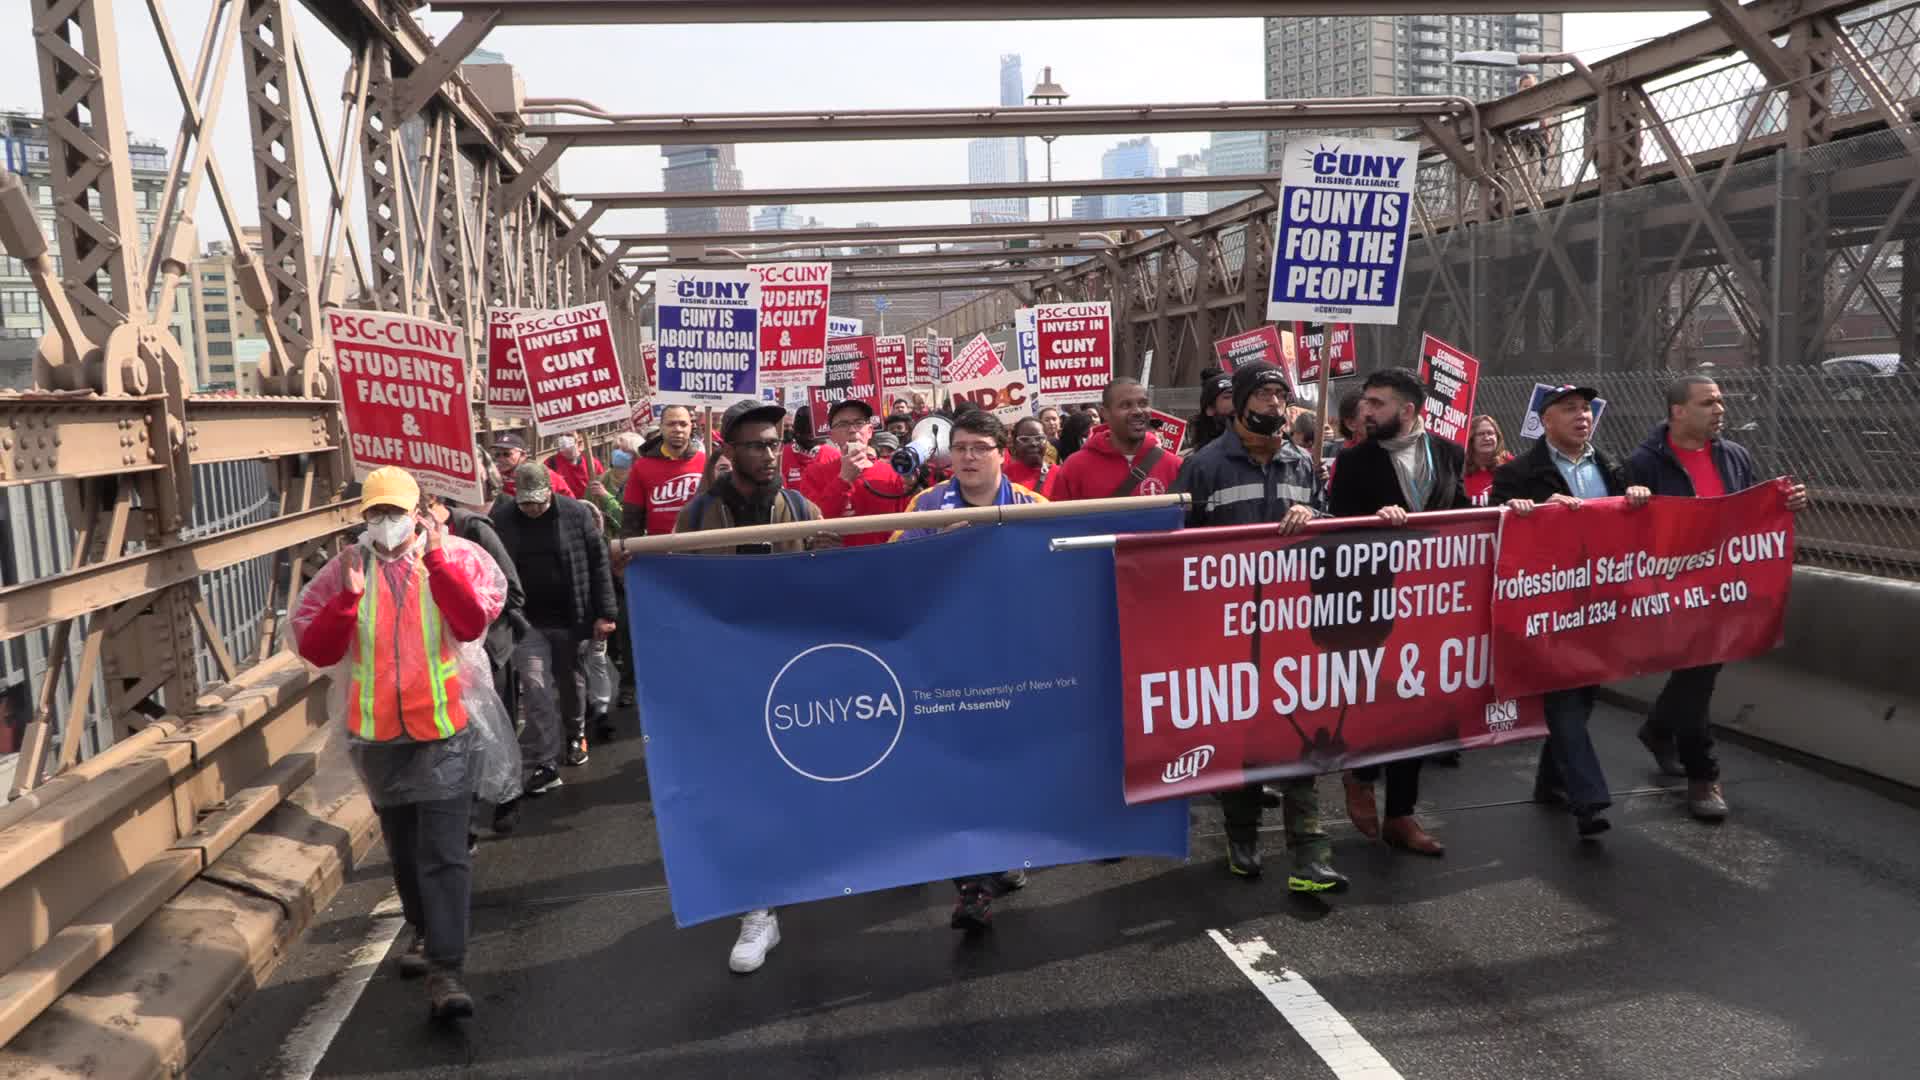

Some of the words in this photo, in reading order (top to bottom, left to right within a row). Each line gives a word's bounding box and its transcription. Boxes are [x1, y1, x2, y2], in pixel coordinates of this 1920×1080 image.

[1313, 152, 1405, 178] CUNY
[1314, 176, 1352, 186] RISING
[1354, 178, 1400, 188] ALLIANCE
[1290, 189, 1368, 225] CUNY
[1370, 193, 1400, 227] IS
[1285, 227, 1341, 263] FOR
[1348, 231, 1397, 264] THE
[750, 266, 828, 282] SC-CUNY
[1286, 266, 1386, 301] PEOPLE
[677, 281, 750, 299] CUNY
[516, 307, 601, 334] PSC-CUNY
[680, 308, 717, 328] CUNY
[719, 309, 734, 328] IS
[1037, 305, 1107, 319] PSC-CUNY
[330, 314, 457, 353] PSC-CUNY
[525, 329, 579, 351] INVEST
[583, 324, 603, 340] IN
[829, 322, 857, 333] UNY
[1042, 320, 1086, 333] INVEST
[1089, 319, 1104, 331] IN
[660, 328, 704, 350] ABOUT
[706, 330, 756, 351] RACIAL
[779, 329, 793, 347] &
[827, 342, 858, 355] CONOMIC
[1051, 337, 1097, 354] CUNY
[1300, 333, 1324, 349] FUND
[1330, 330, 1350, 345] UNY
[542, 347, 596, 373] CUNY
[665, 352, 676, 369] &
[678, 350, 749, 371] ECONOMIC
[781, 348, 823, 366] UNITED
[827, 350, 865, 362] PORTUNITY.
[1044, 357, 1087, 370] INVEST
[1090, 356, 1104, 367] IN
[1309, 348, 1319, 361] &
[339, 349, 463, 395] STUDENTS,
[537, 372, 589, 394] INVEST
[592, 368, 611, 383] IN
[680, 371, 734, 391] JUSTICE
[885, 376, 907, 385] YORK
[1040, 376, 1070, 390] NEW
[1072, 372, 1109, 387] YORK
[356, 379, 452, 416] FACULTY
[490, 389, 526, 402] NEW
[536, 397, 573, 418] NEW
[576, 386, 623, 409] YORK
[814, 387, 842, 404] FUND
[846, 384, 875, 402] SUNY
[1424, 396, 1444, 417] UND
[1443, 405, 1468, 428] SUNY
[402, 413, 422, 436] &
[1424, 413, 1433, 430] &
[1433, 417, 1458, 441] CUNY
[352, 433, 405, 461] STAFF
[408, 441, 473, 474] UNITED
[652, 475, 701, 502] uup
[1183, 546, 1327, 593] ECONOMIC
[1595, 551, 1635, 585] Staff
[1635, 547, 1716, 581] Congress
[1727, 531, 1788, 564] CUNY
[1223, 591, 1363, 637] ECONOMIC
[1369, 580, 1473, 622] JUSTICE.
[1525, 612, 1550, 638] AFT
[1552, 608, 1585, 632] Local
[1588, 600, 1617, 624] 2334
[1683, 586, 1710, 609] AFL
[1720, 580, 1747, 603] CIO
[913, 689, 933, 701] The
[934, 687, 961, 699] State
[963, 682, 1015, 697] University
[1016, 682, 1027, 692] of
[1029, 679, 1053, 690] New
[1055, 676, 1078, 687] York
[1140, 661, 1260, 735] FUND
[1272, 646, 1386, 715] SUNY
[1396, 642, 1426, 699] &
[1439, 634, 1494, 694] CU
[774, 693, 898, 731] SUNYSA
[913, 702, 956, 715] Student
[958, 698, 1012, 711] Assembly
[1487, 701, 1516, 722] PSC
[1489, 721, 1515, 733] CUNY
[1163, 745, 1214, 783] uup
